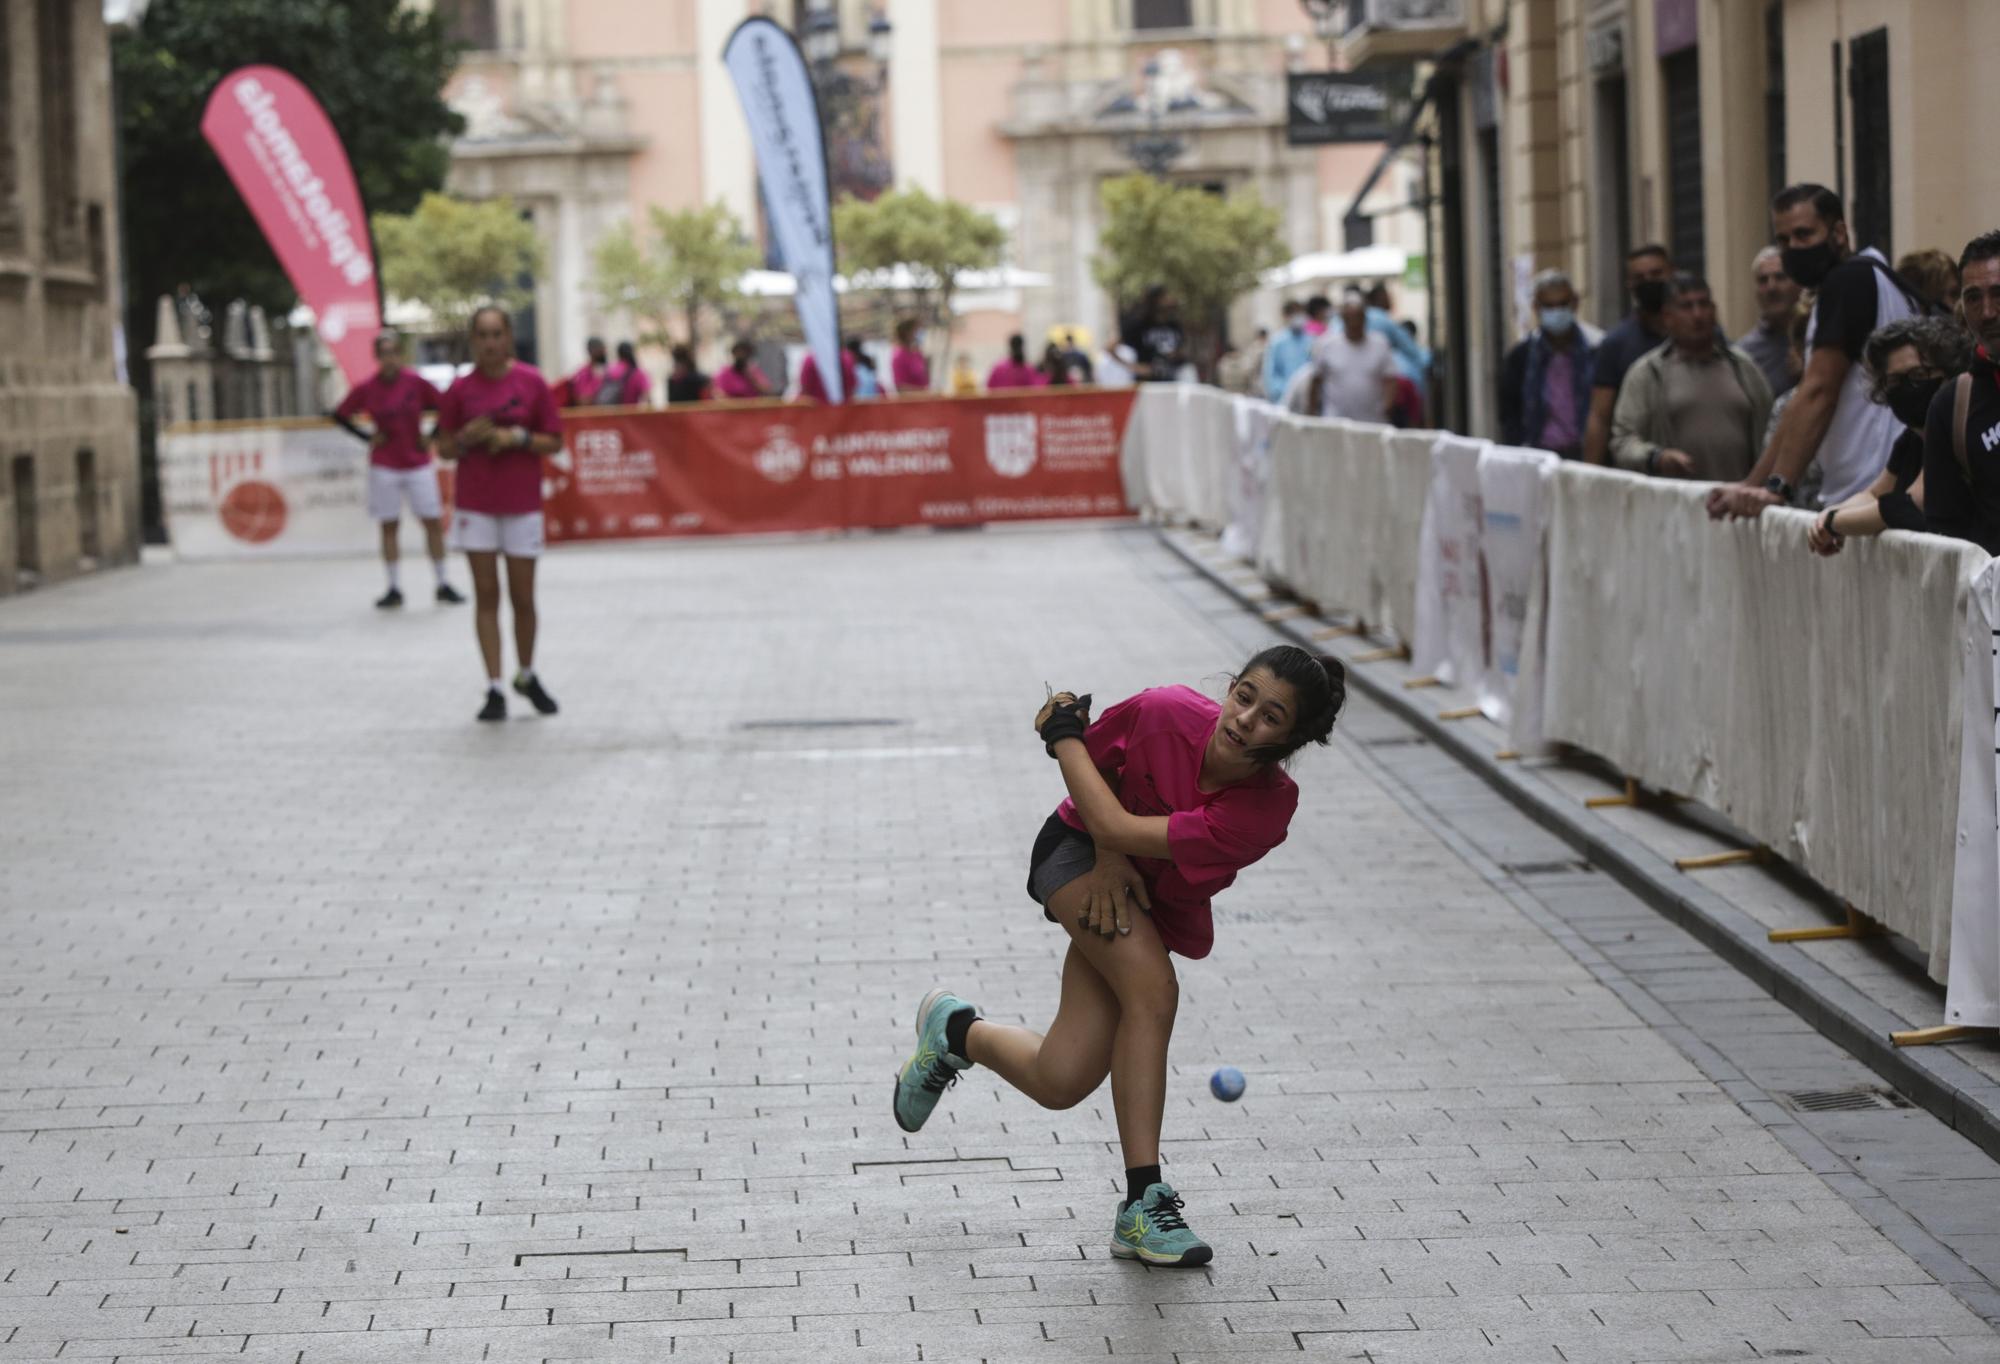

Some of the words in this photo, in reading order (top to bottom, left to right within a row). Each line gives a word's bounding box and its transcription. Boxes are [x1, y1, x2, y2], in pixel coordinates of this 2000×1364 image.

[576, 430, 622, 451] FES
[812, 428, 950, 454] AJUNTAMENT
[811, 457, 842, 480] DE
